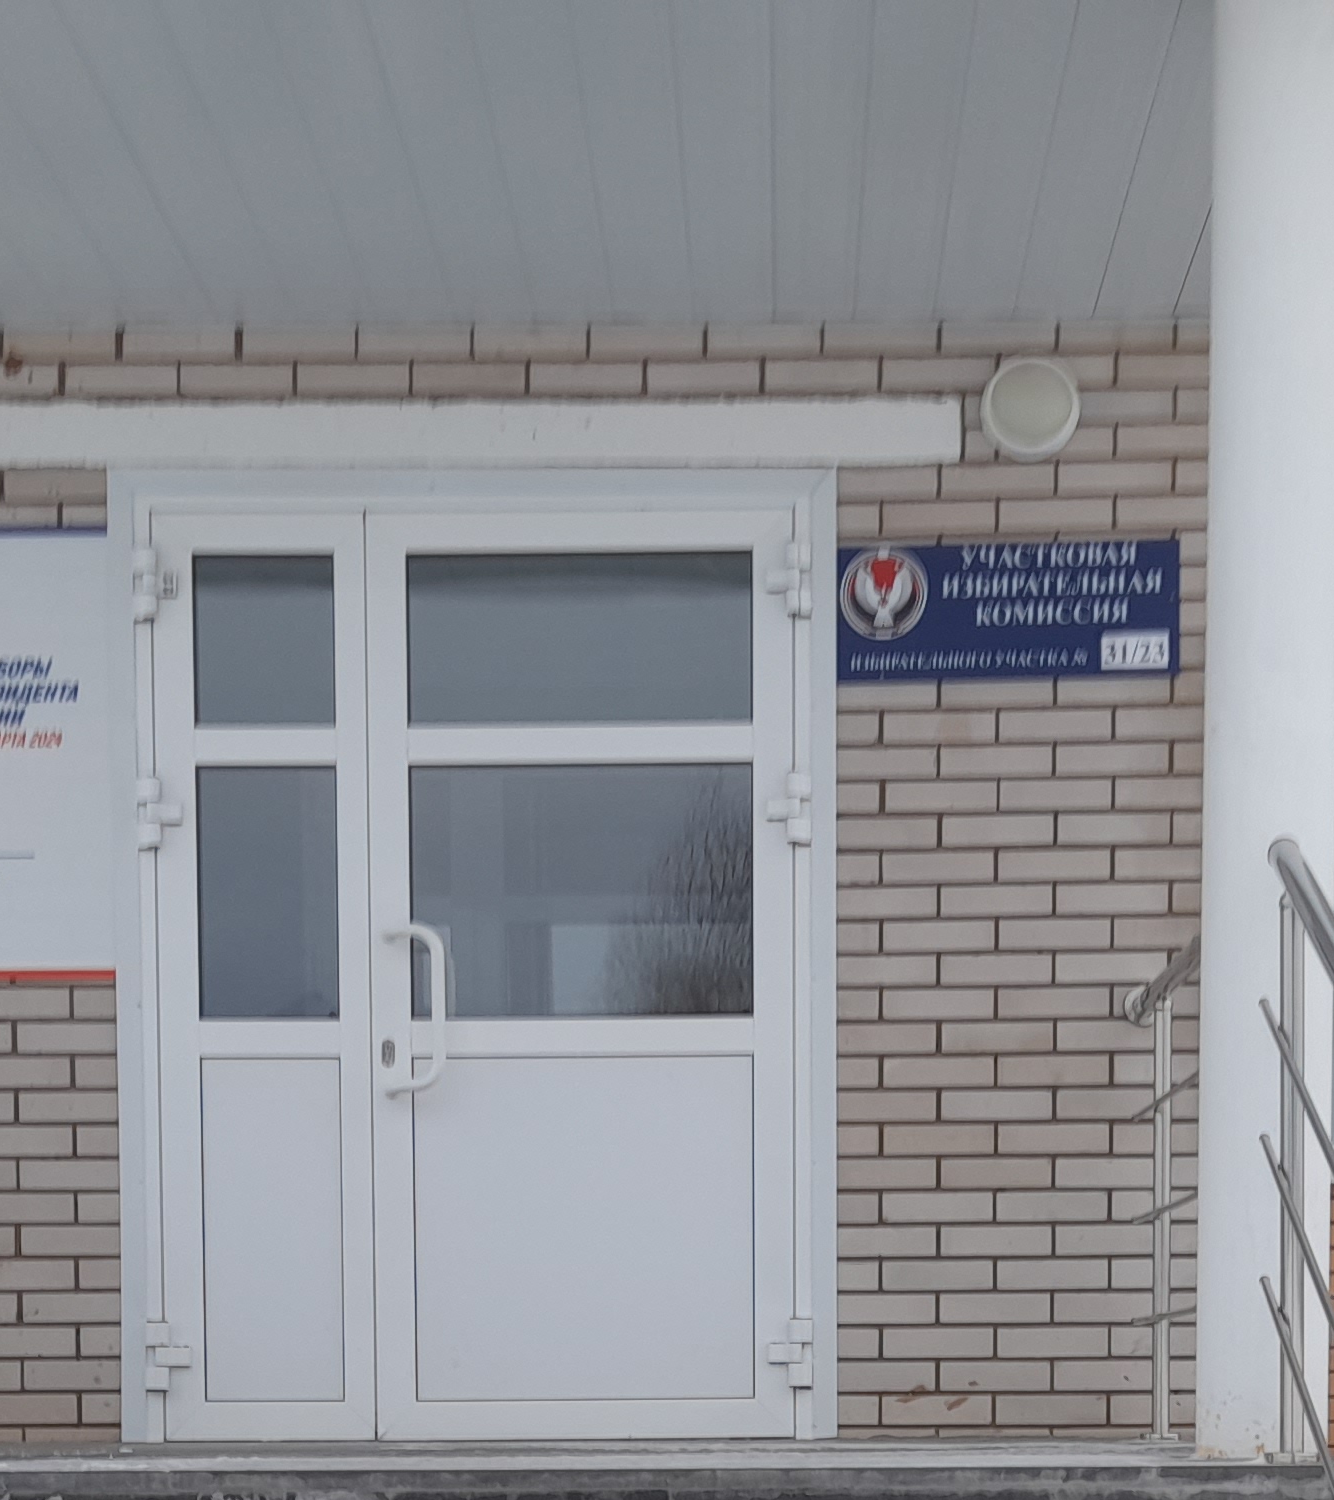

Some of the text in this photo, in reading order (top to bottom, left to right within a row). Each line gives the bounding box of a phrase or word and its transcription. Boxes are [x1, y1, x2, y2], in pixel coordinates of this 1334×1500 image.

[961, 540, 1138, 570] УЧАСТКОВАЯ
[942, 567, 1163, 599] ИЗБИРАТЕЛЬНАЯ
[976, 599, 1130, 627] КОМИССИЯ
[29, 728, 63, 749] 2024
